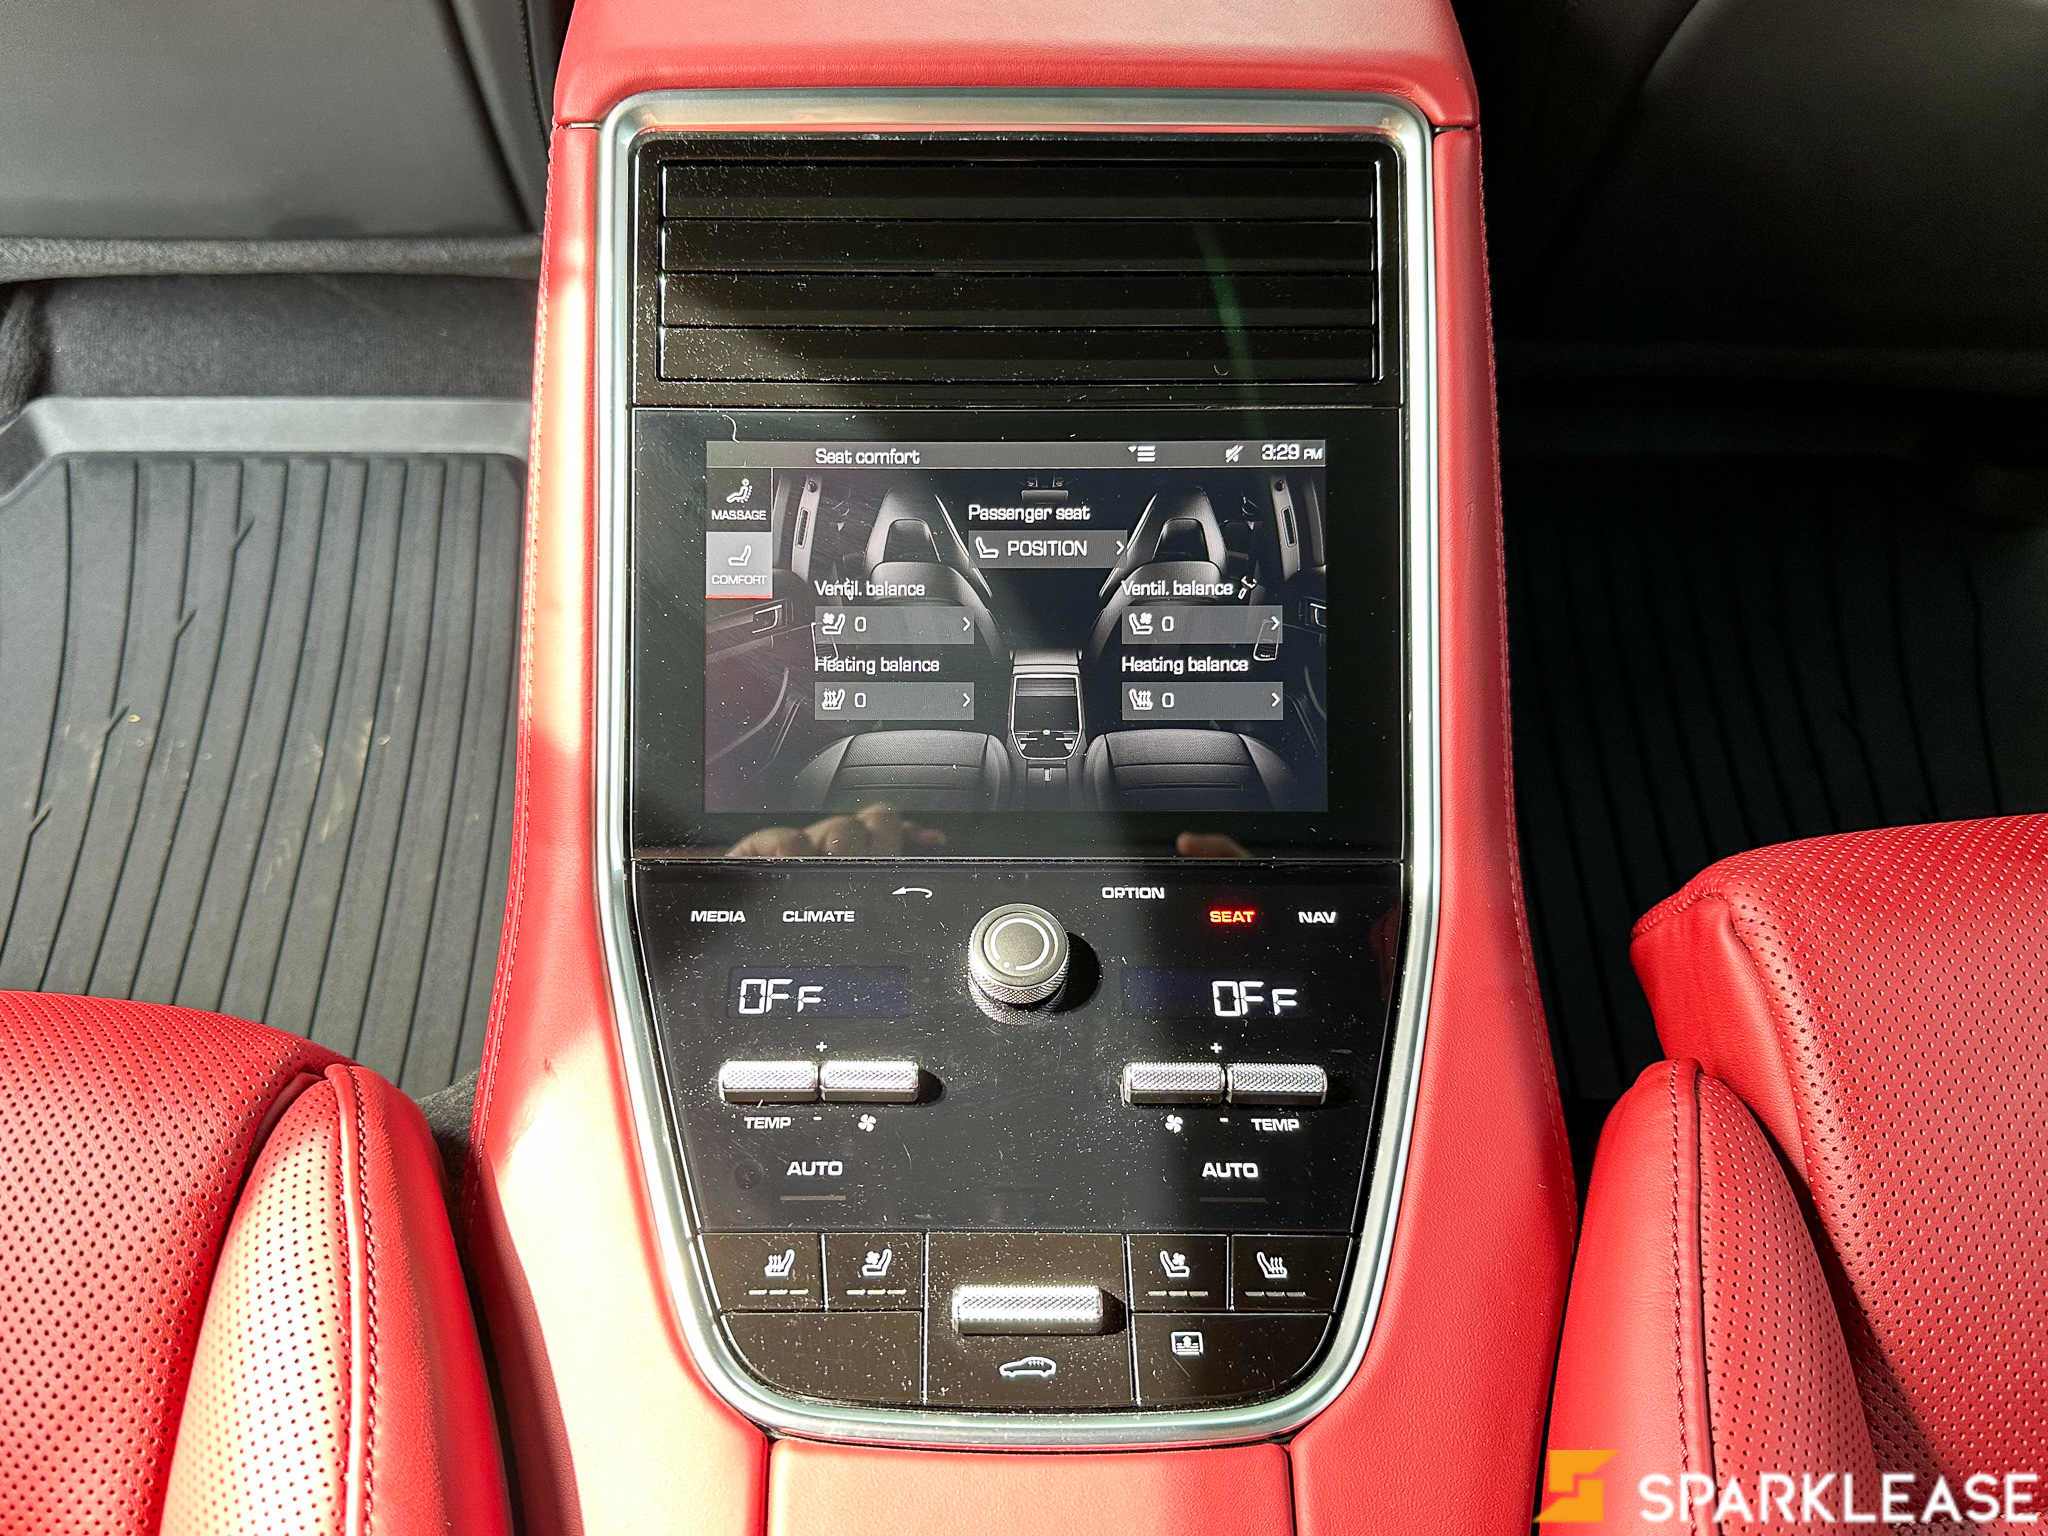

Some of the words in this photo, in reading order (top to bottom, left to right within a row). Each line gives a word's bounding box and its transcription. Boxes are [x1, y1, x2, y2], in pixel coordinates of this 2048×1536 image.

[815, 448, 853, 465] Seat
[856, 447, 921, 465] comfort
[1261, 443, 1300, 461] 3:29
[1303, 448, 1324, 460] PM
[711, 510, 767, 521] MASSAGE
[968, 504, 1052, 523] Passenger
[1055, 505, 1091, 520] seat
[1007, 540, 1088, 557] POSITION
[711, 574, 767, 586] COMFORT
[814, 580, 863, 597] Ventil.
[866, 580, 926, 597] balance
[1121, 580, 1170, 597] Ventil.
[1173, 580, 1234, 596] balance
[854, 616, 867, 632] 0
[1161, 615, 1175, 632] 0
[814, 656, 876, 675] Heating
[880, 656, 940, 673] balance
[1121, 656, 1184, 675] Heating
[1187, 656, 1249, 673] balance
[854, 692, 867, 708] 0
[1161, 692, 1175, 708] 0
[1101, 886, 1165, 900] OPTION
[690, 910, 746, 923] MEDIA
[782, 910, 856, 923] CLIMATE
[1209, 910, 1256, 923] SEAT
[1298, 911, 1337, 924] NAV
[743, 1116, 792, 1130] TEMP
[1250, 1118, 1301, 1132] TEMP
[786, 1161, 844, 1176] AUTO
[1201, 1162, 1259, 1178] AUTO
